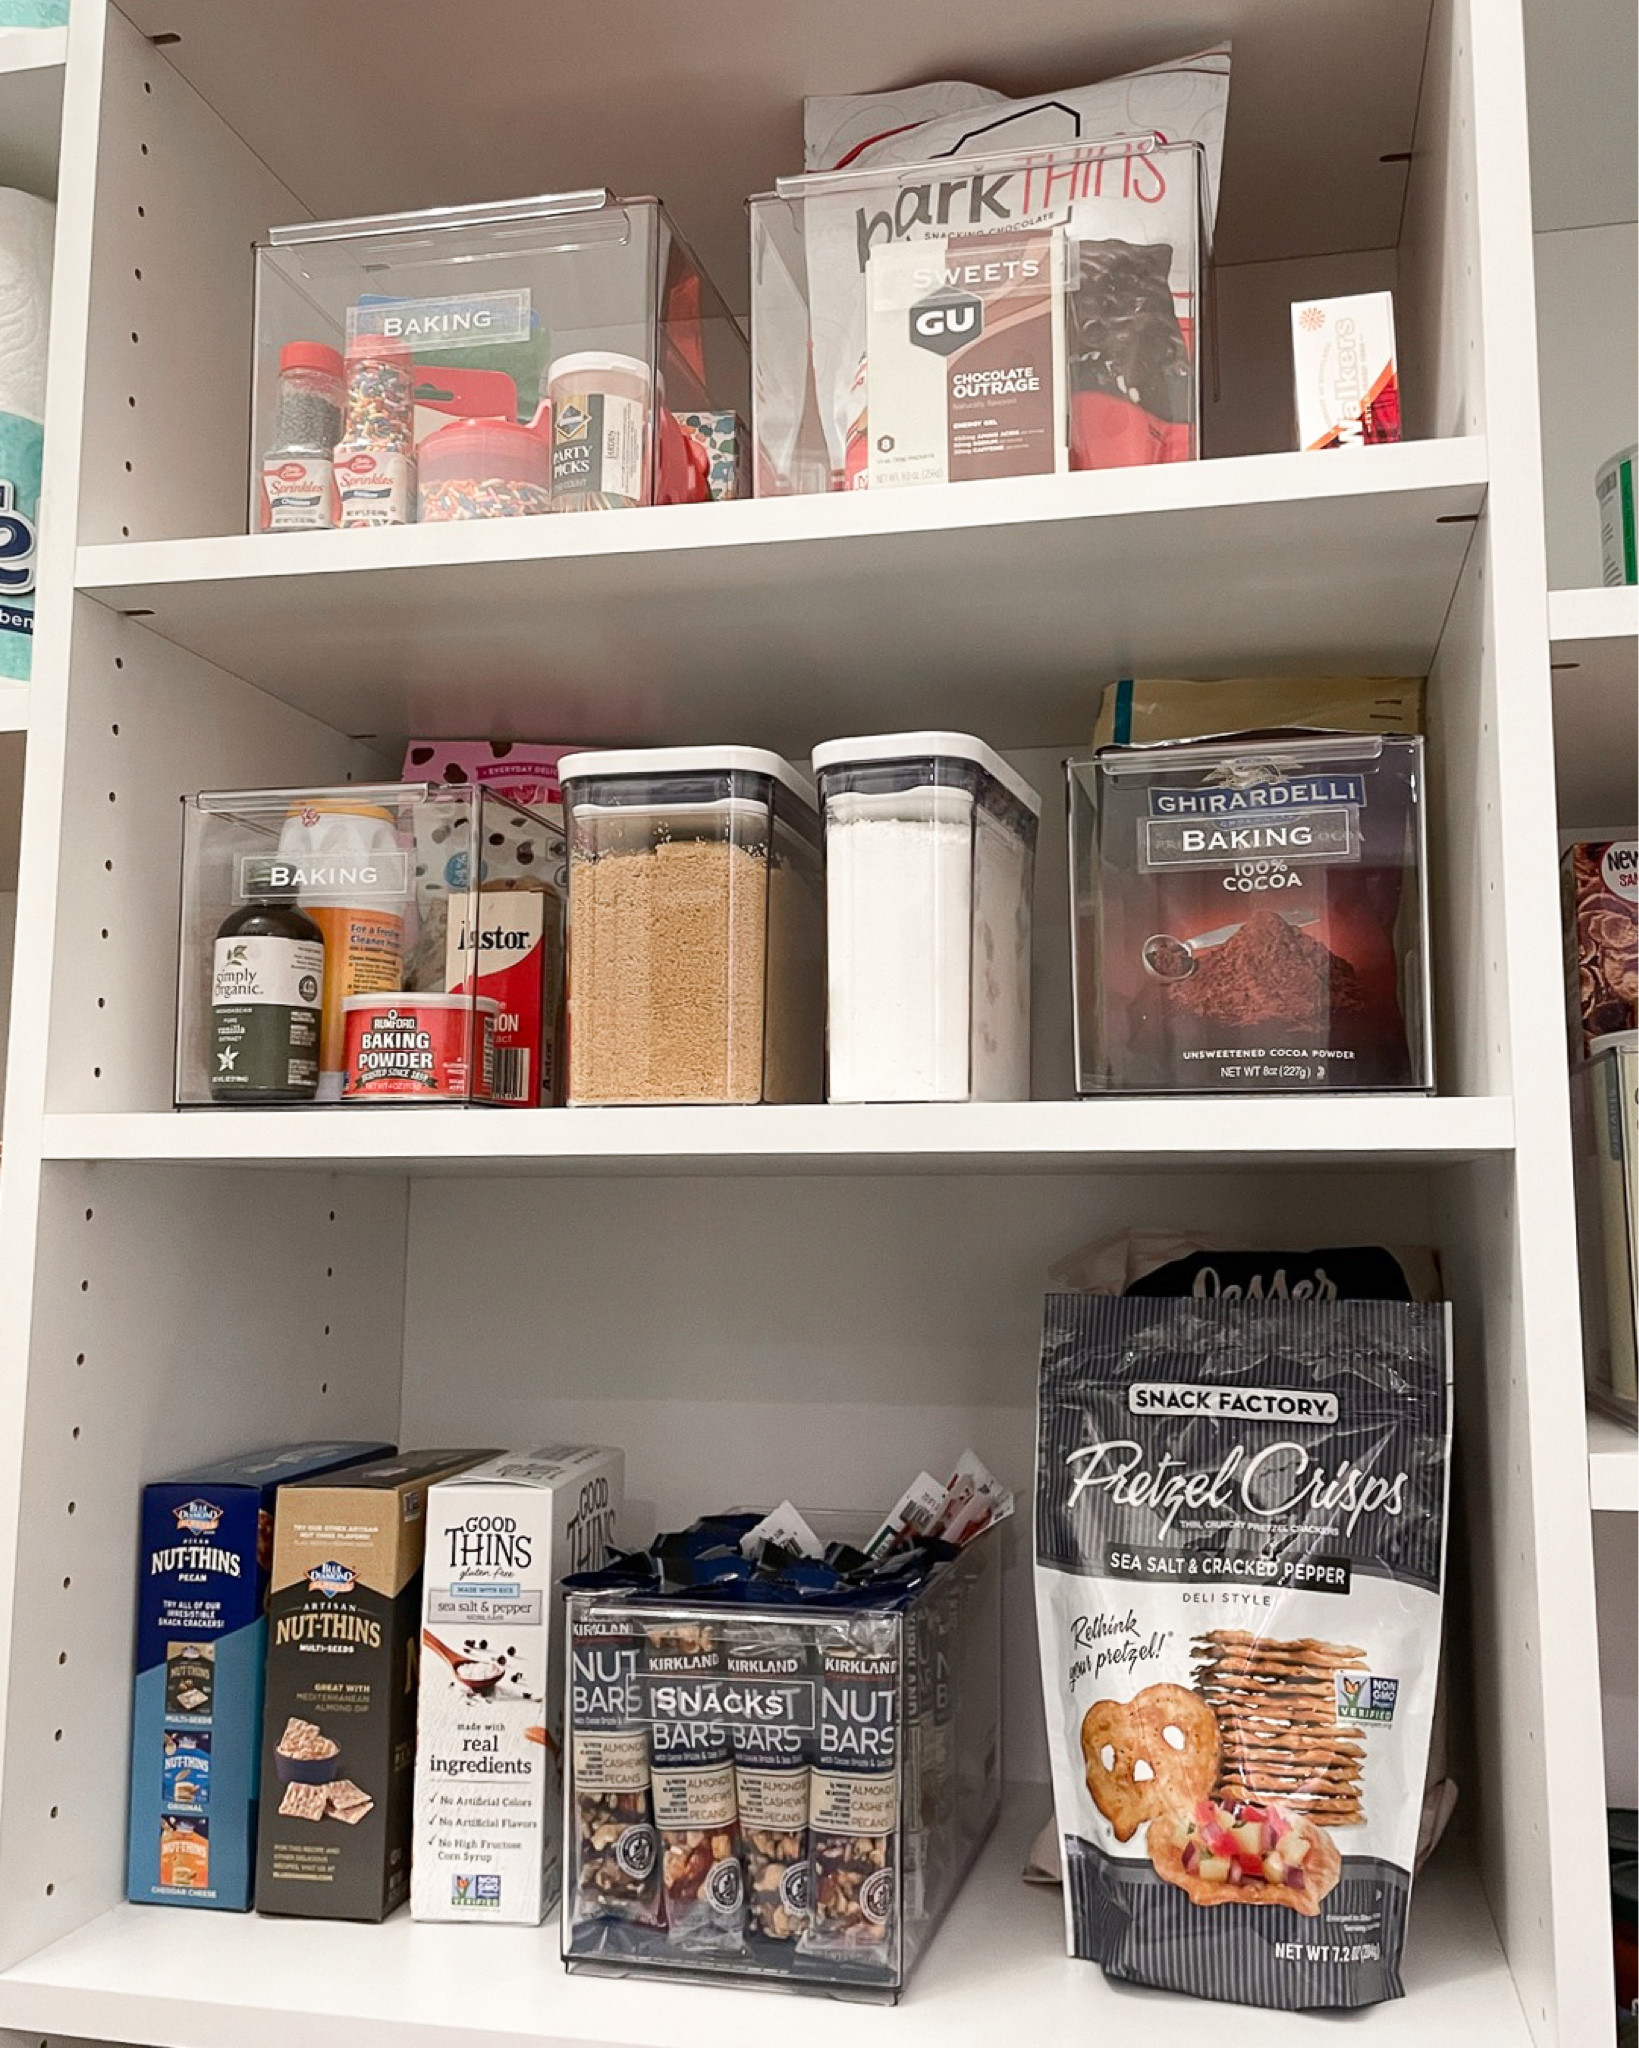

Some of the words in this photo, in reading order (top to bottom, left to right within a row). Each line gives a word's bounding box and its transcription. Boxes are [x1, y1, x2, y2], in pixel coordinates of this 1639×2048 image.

[912, 259, 1041, 288] SWEETS
[383, 310, 492, 338] BAKING
[915, 307, 975, 336] GU
[953, 366, 1034, 386] CHOCOLATE
[953, 377, 1040, 399] OUTRAGE
[270, 481, 324, 496] Sprinkles
[340, 472, 394, 488] Sprinkles
[488, 767, 532, 777] EVERYDAY
[1157, 782, 1357, 814] GHIRARDELLI
[1182, 826, 1313, 852] BAKING
[269, 867, 378, 887] BAKING
[1234, 858, 1289, 877] 100%
[1222, 872, 1303, 893] COCOA
[361, 1032, 430, 1050] BAKING
[358, 1052, 434, 1069] POWDER
[1183, 1049, 1266, 1060] UNSWEETENED
[1269, 1048, 1309, 1058] COCOA
[1311, 1049, 1356, 1060] POWDER
[1220, 1066, 1242, 1078] NET
[1243, 1065, 1261, 1077] WT
[1135, 1389, 1212, 1411] SNACK
[1219, 1393, 1331, 1418] FACTORY
[579, 1476, 609, 1522] GOOD
[1065, 1439, 1246, 1542] Pretzel
[1241, 1441, 1410, 1538] Crisps
[465, 1516, 517, 1534] GOOD
[1203, 1521, 1247, 1530] CRUNCHY
[444, 1525, 533, 1569] THINS
[151, 1546, 241, 1577] NUT-THINS
[1109, 1550, 1143, 1573] SEA
[1145, 1554, 1187, 1576] SALT
[1187, 1556, 1199, 1575] &
[1201, 1555, 1280, 1580] CRACKED
[1283, 1560, 1347, 1586] PEPPER
[179, 1573, 207, 1582] PECAN
[459, 1567, 490, 1581] gluten
[303, 1602, 357, 1612] ARTISAN
[437, 1601, 456, 1612] sea
[458, 1599, 479, 1612] salt
[480, 1600, 490, 1612] &
[491, 1603, 534, 1616] pepper
[1182, 1591, 1216, 1604] DELI
[1222, 1592, 1272, 1608] STYLE
[275, 1613, 382, 1649] NUT-THINS
[1070, 1608, 1142, 1652] Rethink
[299, 1643, 355, 1653] MULTI-SEEDS
[572, 1649, 641, 1683] NUT
[649, 1653, 720, 1672] KIRKLAND
[727, 1658, 799, 1674] KIRKLAND
[313, 1683, 344, 1693] GREAT
[346, 1684, 371, 1693] WITH
[1372, 1678, 1397, 1691] NON
[573, 1684, 643, 1714] BARS
[656, 1686, 784, 1716] SNACKS
[821, 1686, 898, 1723] NUT
[456, 1721, 482, 1731] made
[484, 1721, 506, 1732] with
[653, 1718, 726, 1750] BARS
[462, 1734, 499, 1752] real
[732, 1724, 802, 1752] BARS
[820, 1722, 896, 1756] BARS
[429, 1754, 533, 1776] ingredients
[439, 1796, 453, 1806] No
[456, 1796, 500, 1807] Artificial
[501, 1797, 533, 1808] Colors
[439, 1817, 453, 1827] No
[455, 1818, 499, 1828] Artificial
[501, 1819, 538, 1829] Flavors
[438, 1838, 452, 1849] No
[454, 1838, 478, 1850] High
[437, 1851, 461, 1862] Corn
[463, 1851, 493, 1863] Syrup
[1275, 1942, 1304, 1960] NET
[1305, 1944, 1330, 1962] WT
[1331, 1945, 1351, 1963] 7.2
